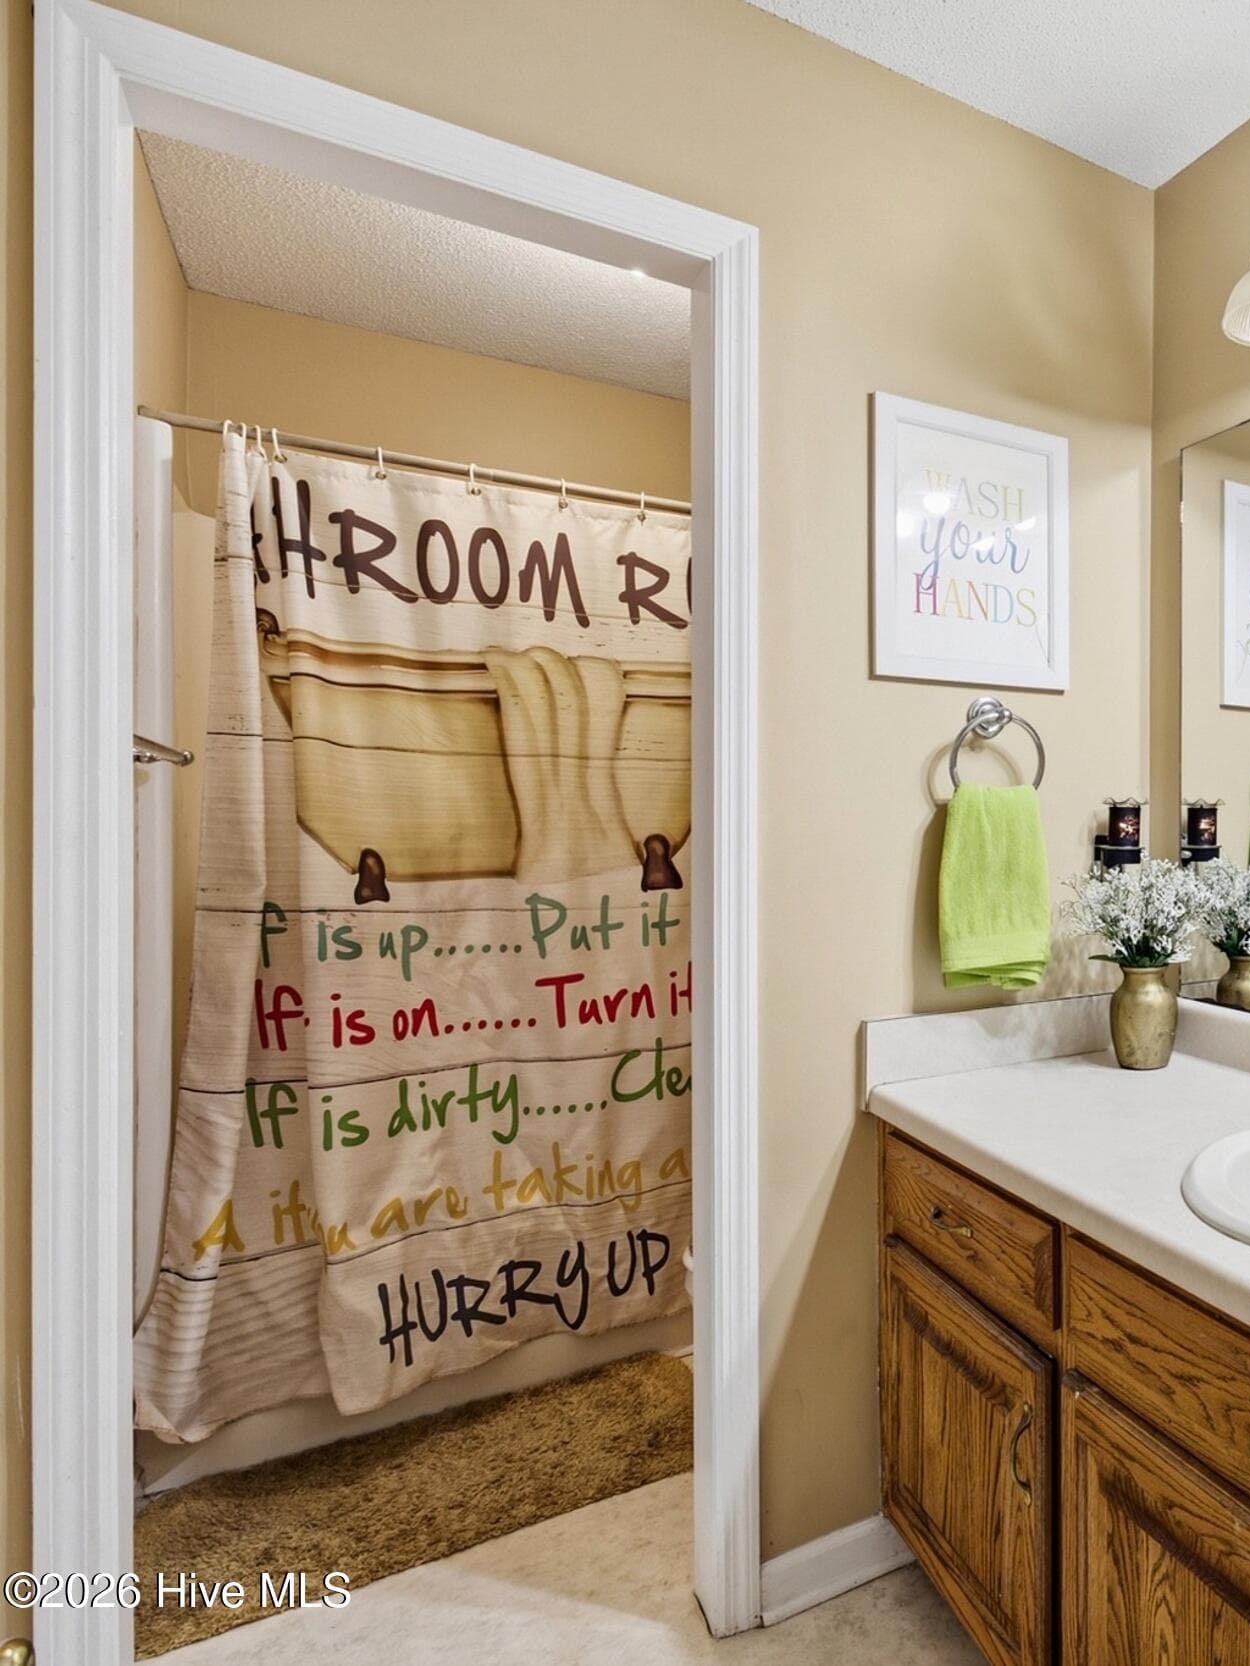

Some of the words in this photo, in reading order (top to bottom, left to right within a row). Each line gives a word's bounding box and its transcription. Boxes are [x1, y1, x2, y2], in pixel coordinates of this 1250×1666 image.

[250, 476, 590, 628] HROOM
[616, 551, 692, 630] R
[920, 516, 1030, 591] your
[912, 572, 1038, 627] HANDS
[261, 901, 288, 968] f
[317, 909, 363, 962] is
[641, 892, 680, 947] it
[330, 993, 376, 1049] is
[245, 1077, 299, 1150] If
[321, 1095, 370, 1151] is
[611, 1037, 692, 1103] Cle
[371, 1187, 468, 1241] are
[482, 1142, 643, 1211] taking
[659, 1148, 691, 1181] a
[378, 1240, 590, 1368] HURRY
[607, 1228, 671, 1297] UP
